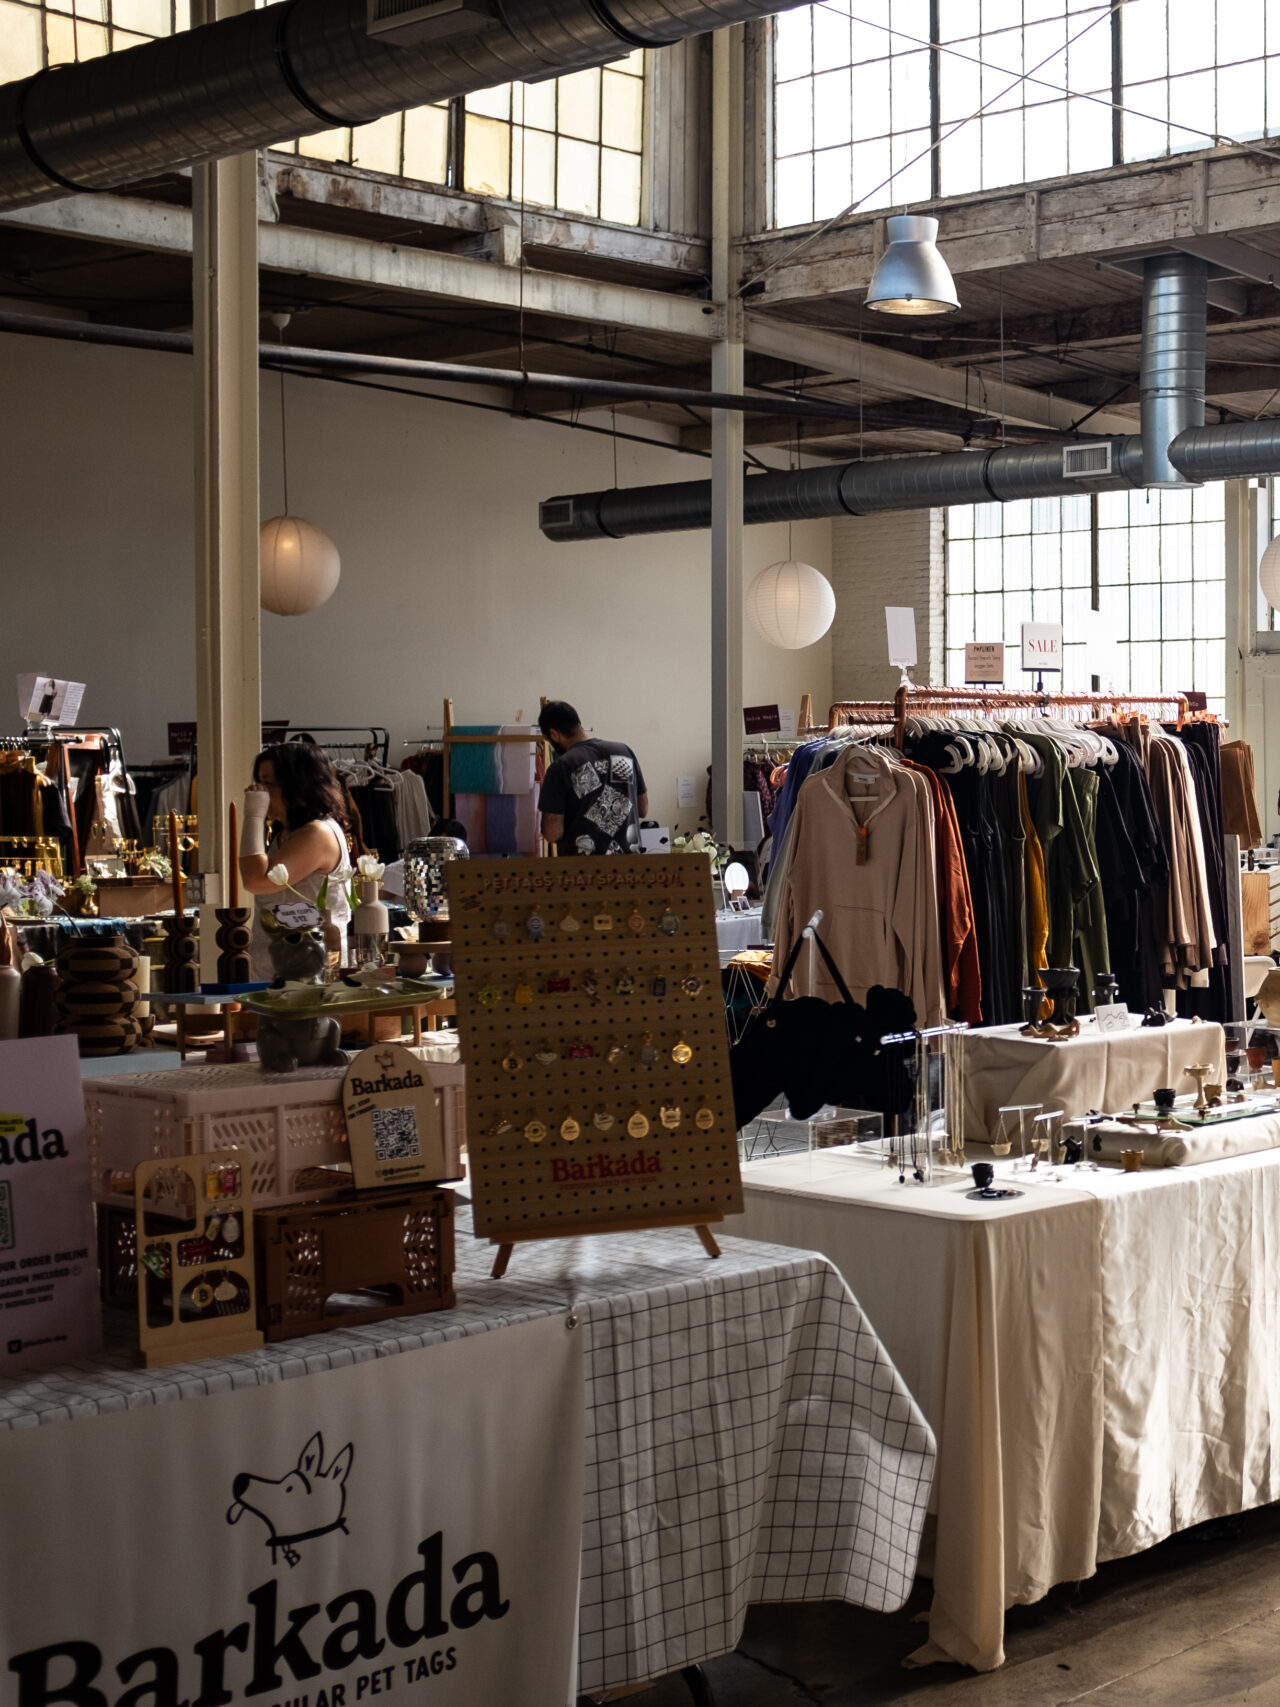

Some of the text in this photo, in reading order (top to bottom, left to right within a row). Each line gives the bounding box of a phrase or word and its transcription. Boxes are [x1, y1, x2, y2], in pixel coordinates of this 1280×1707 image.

[1028, 638, 1058, 653] SALE
[483, 871, 681, 890] PET TAGS THAT SPARK JOY!
[350, 1070, 424, 1096] Barkada
[550, 1149, 662, 1182] Barkada
[19, 1254, 51, 1269] ORDER
[54, 1248, 88, 1263] ONLINE
[8, 1530, 511, 1707] Barkada
[356, 1665, 395, 1700] PET
[403, 1646, 457, 1684] TAGS
